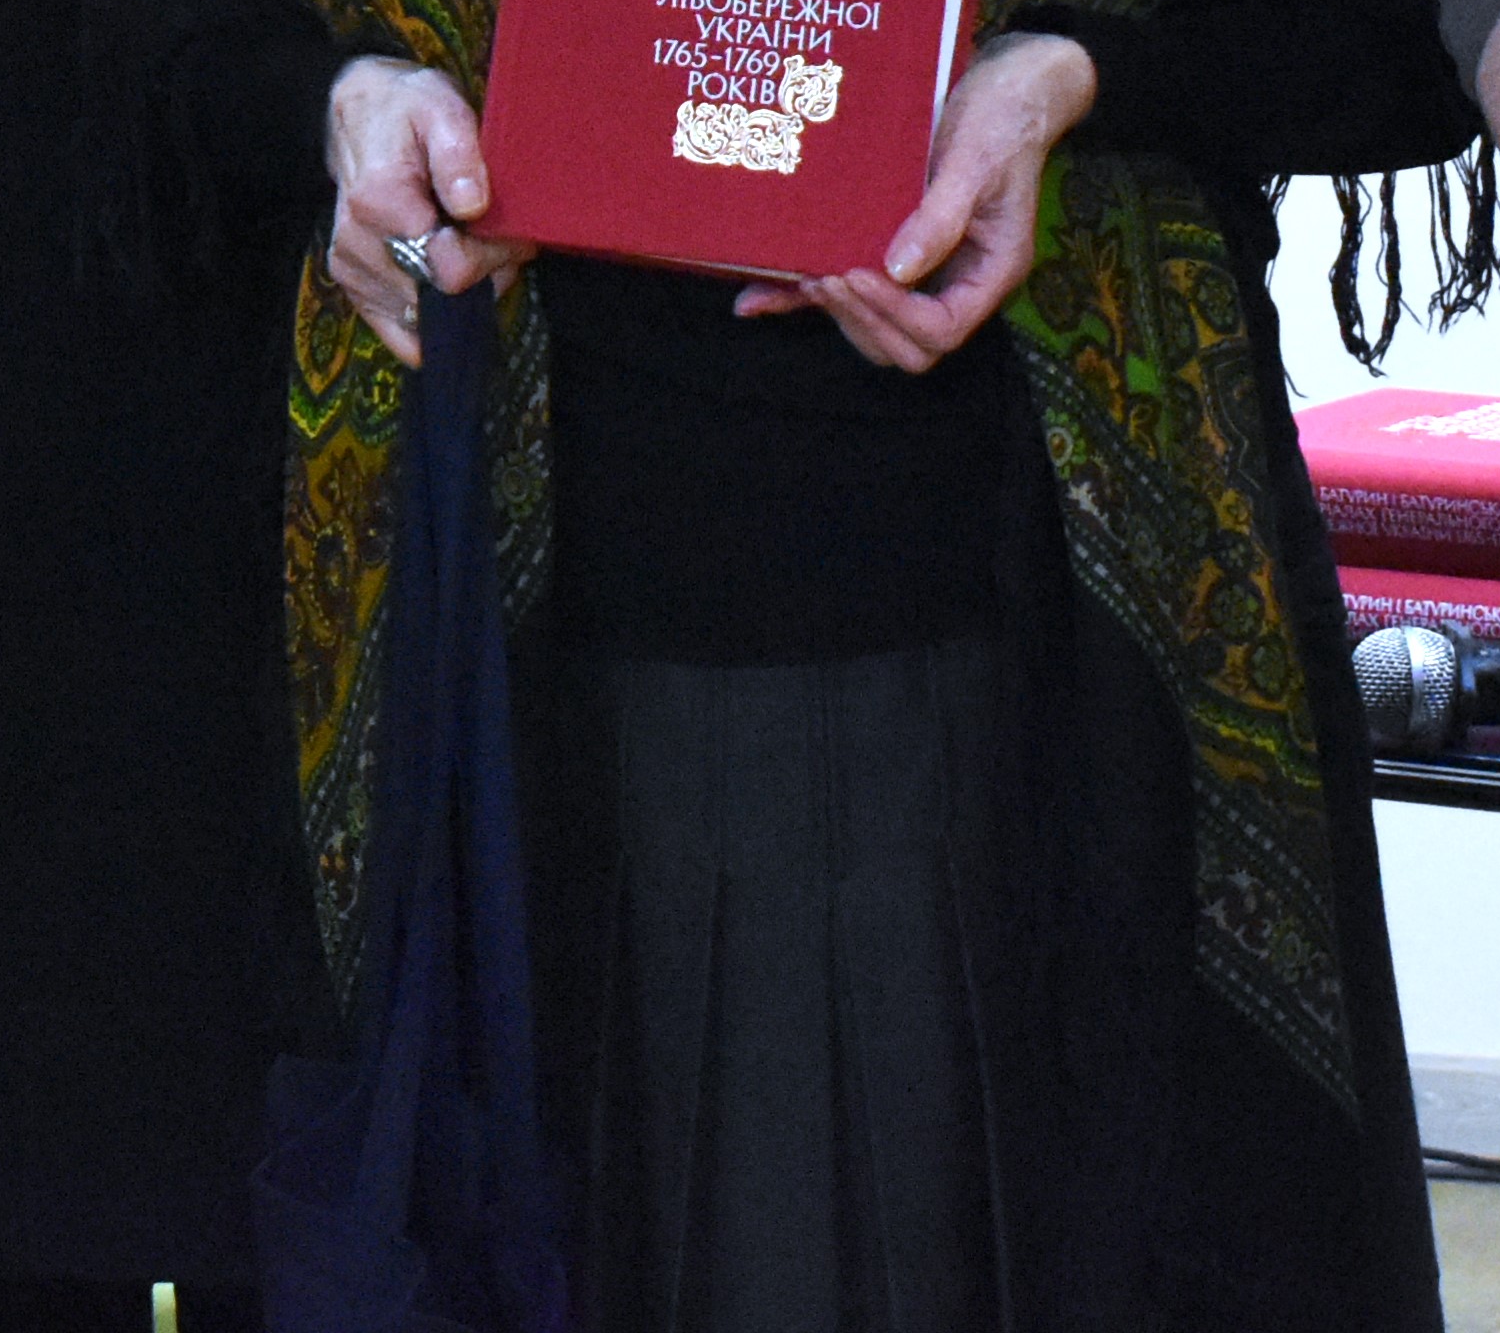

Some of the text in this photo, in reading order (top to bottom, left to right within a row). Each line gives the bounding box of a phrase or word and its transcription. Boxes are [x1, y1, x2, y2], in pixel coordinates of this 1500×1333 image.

[653, 38, 780, 76] 1765-1769
[687, 70, 776, 105] РОКІВ
[1342, 593, 1393, 613] ТУРИН
